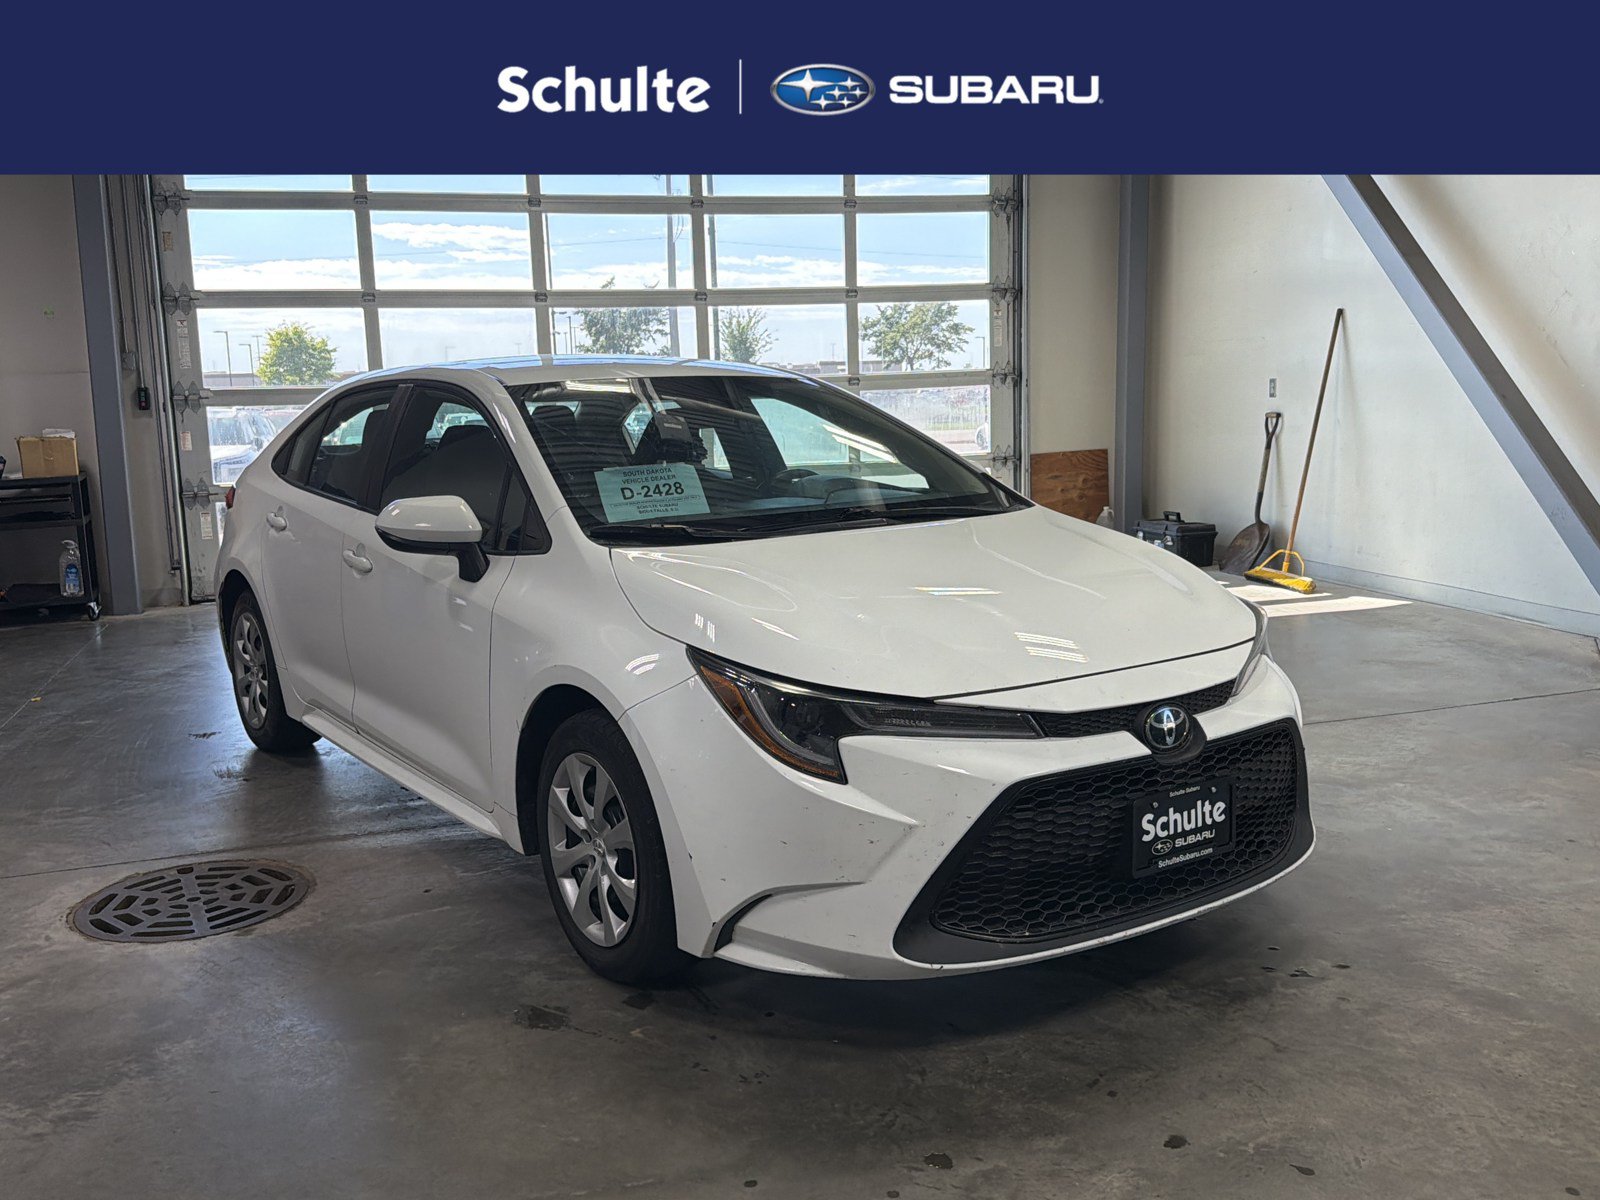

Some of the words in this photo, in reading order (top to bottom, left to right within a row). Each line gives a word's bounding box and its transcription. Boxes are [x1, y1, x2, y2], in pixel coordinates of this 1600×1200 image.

[620, 482, 684, 500] D-2428
[1169, 789, 1185, 797] Schulte
[1141, 800, 1226, 842] Schulte
[1175, 829, 1215, 847] SUBARU
[1158, 848, 1213, 868] SchulteSubaru.com
